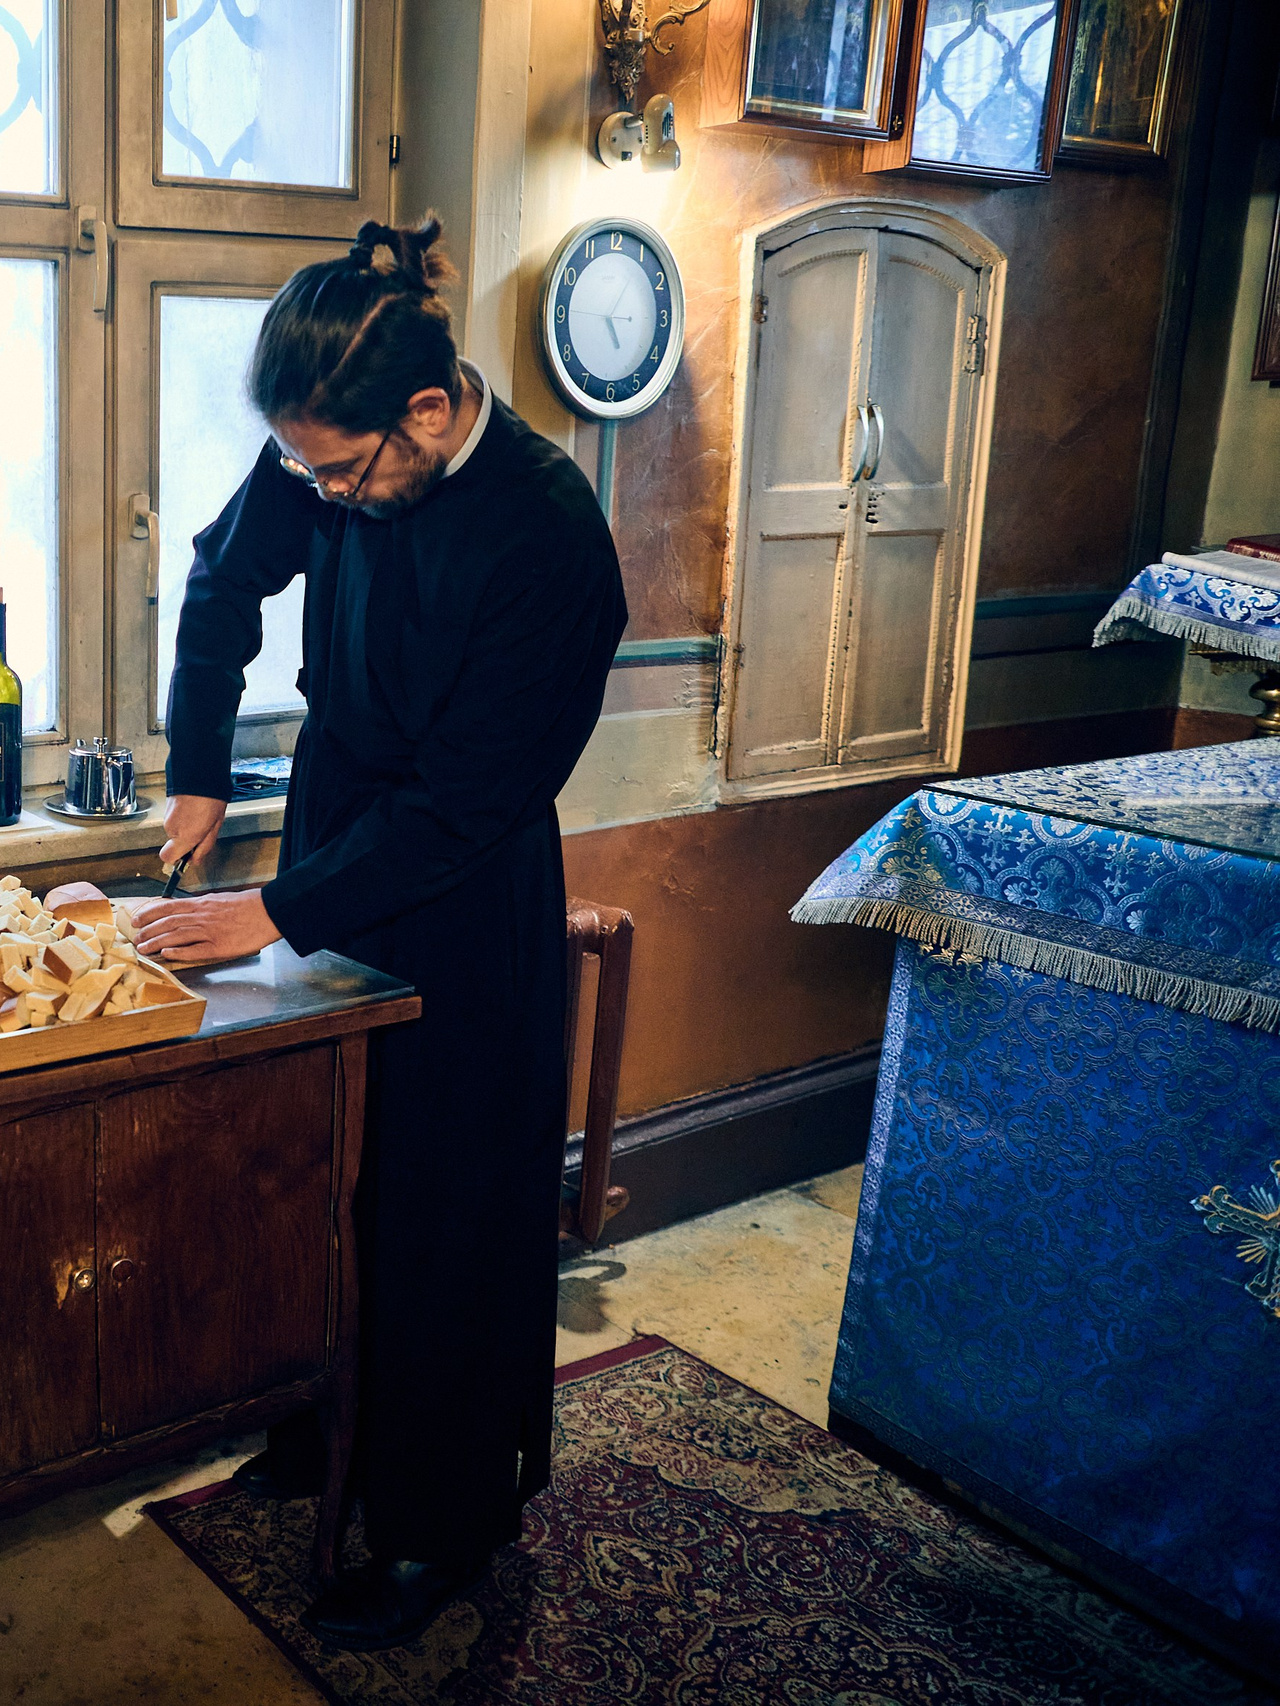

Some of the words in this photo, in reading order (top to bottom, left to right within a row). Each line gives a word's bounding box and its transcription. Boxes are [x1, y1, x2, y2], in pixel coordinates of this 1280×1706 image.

[585, 240, 595, 258] 11
[610, 231, 623, 251] 12
[640, 244, 644, 262] 1
[564, 266, 577, 286] 10
[655, 271, 665, 291] 2
[556, 305, 566, 323] 9
[660, 309, 668, 328] 3
[563, 343, 571, 362] 8
[649, 345, 659, 363] 4
[581, 372, 590, 391] 7
[631, 373, 640, 391] 5
[606, 382, 615, 400] 6
